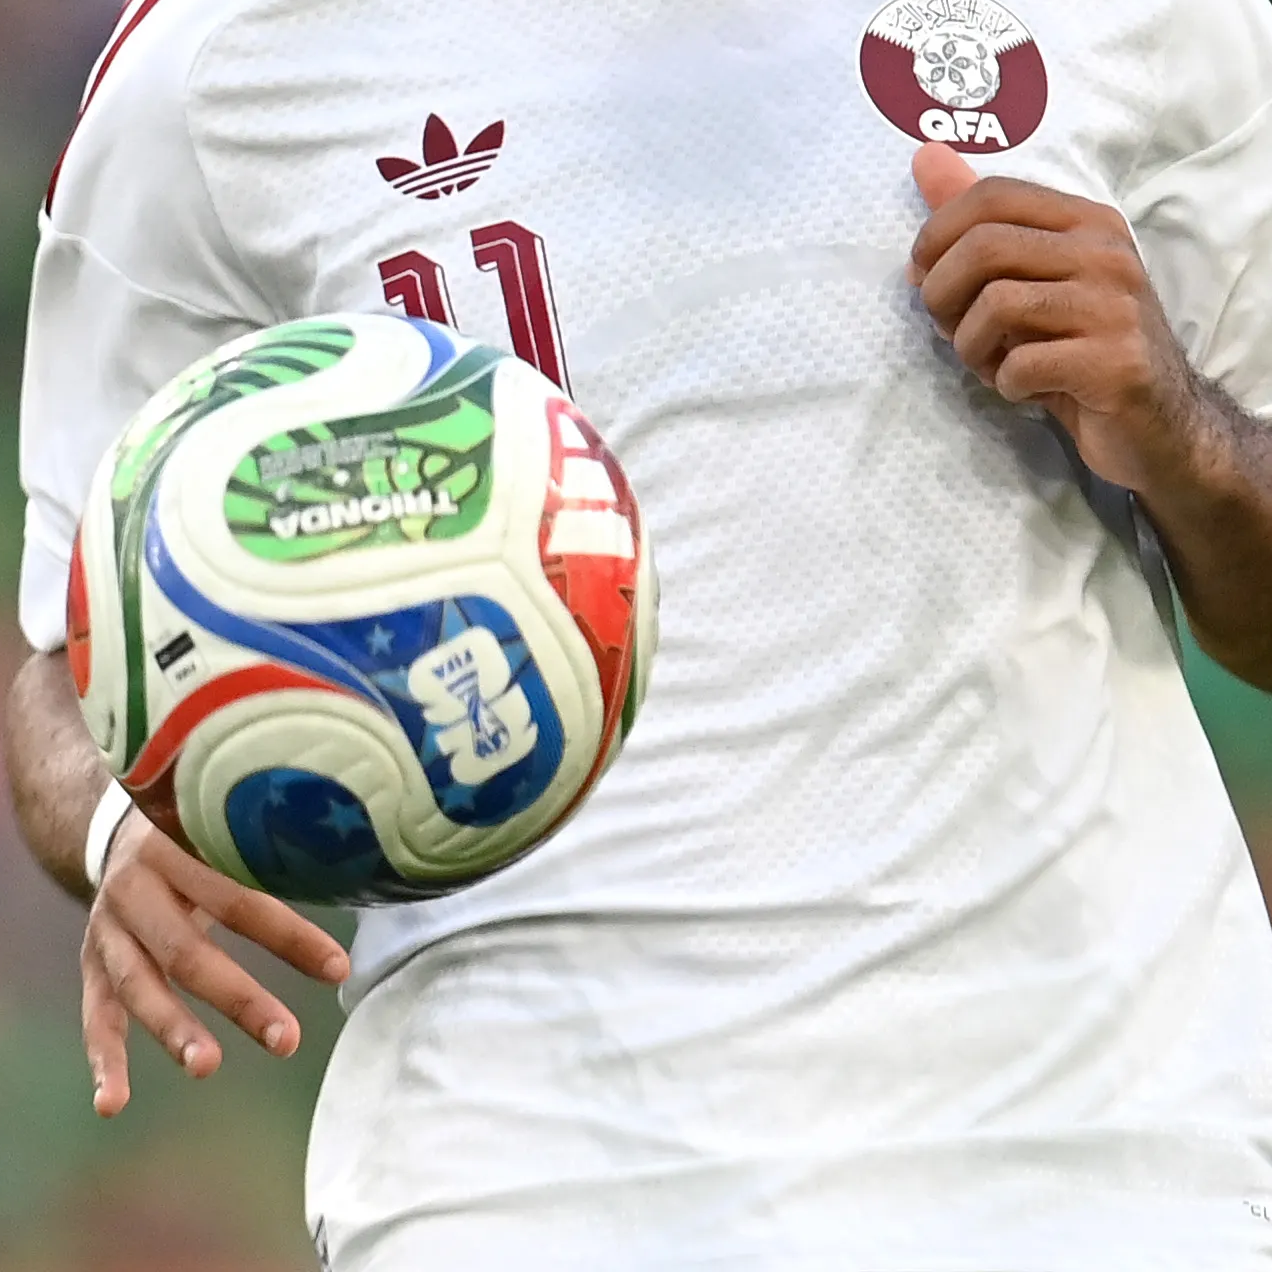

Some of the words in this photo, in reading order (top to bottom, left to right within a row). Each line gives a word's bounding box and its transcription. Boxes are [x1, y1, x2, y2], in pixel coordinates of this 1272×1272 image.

[918, 108, 1011, 148] QFA
[268, 487, 459, 540] TRIONDA
[431, 650, 474, 682] FIFA
